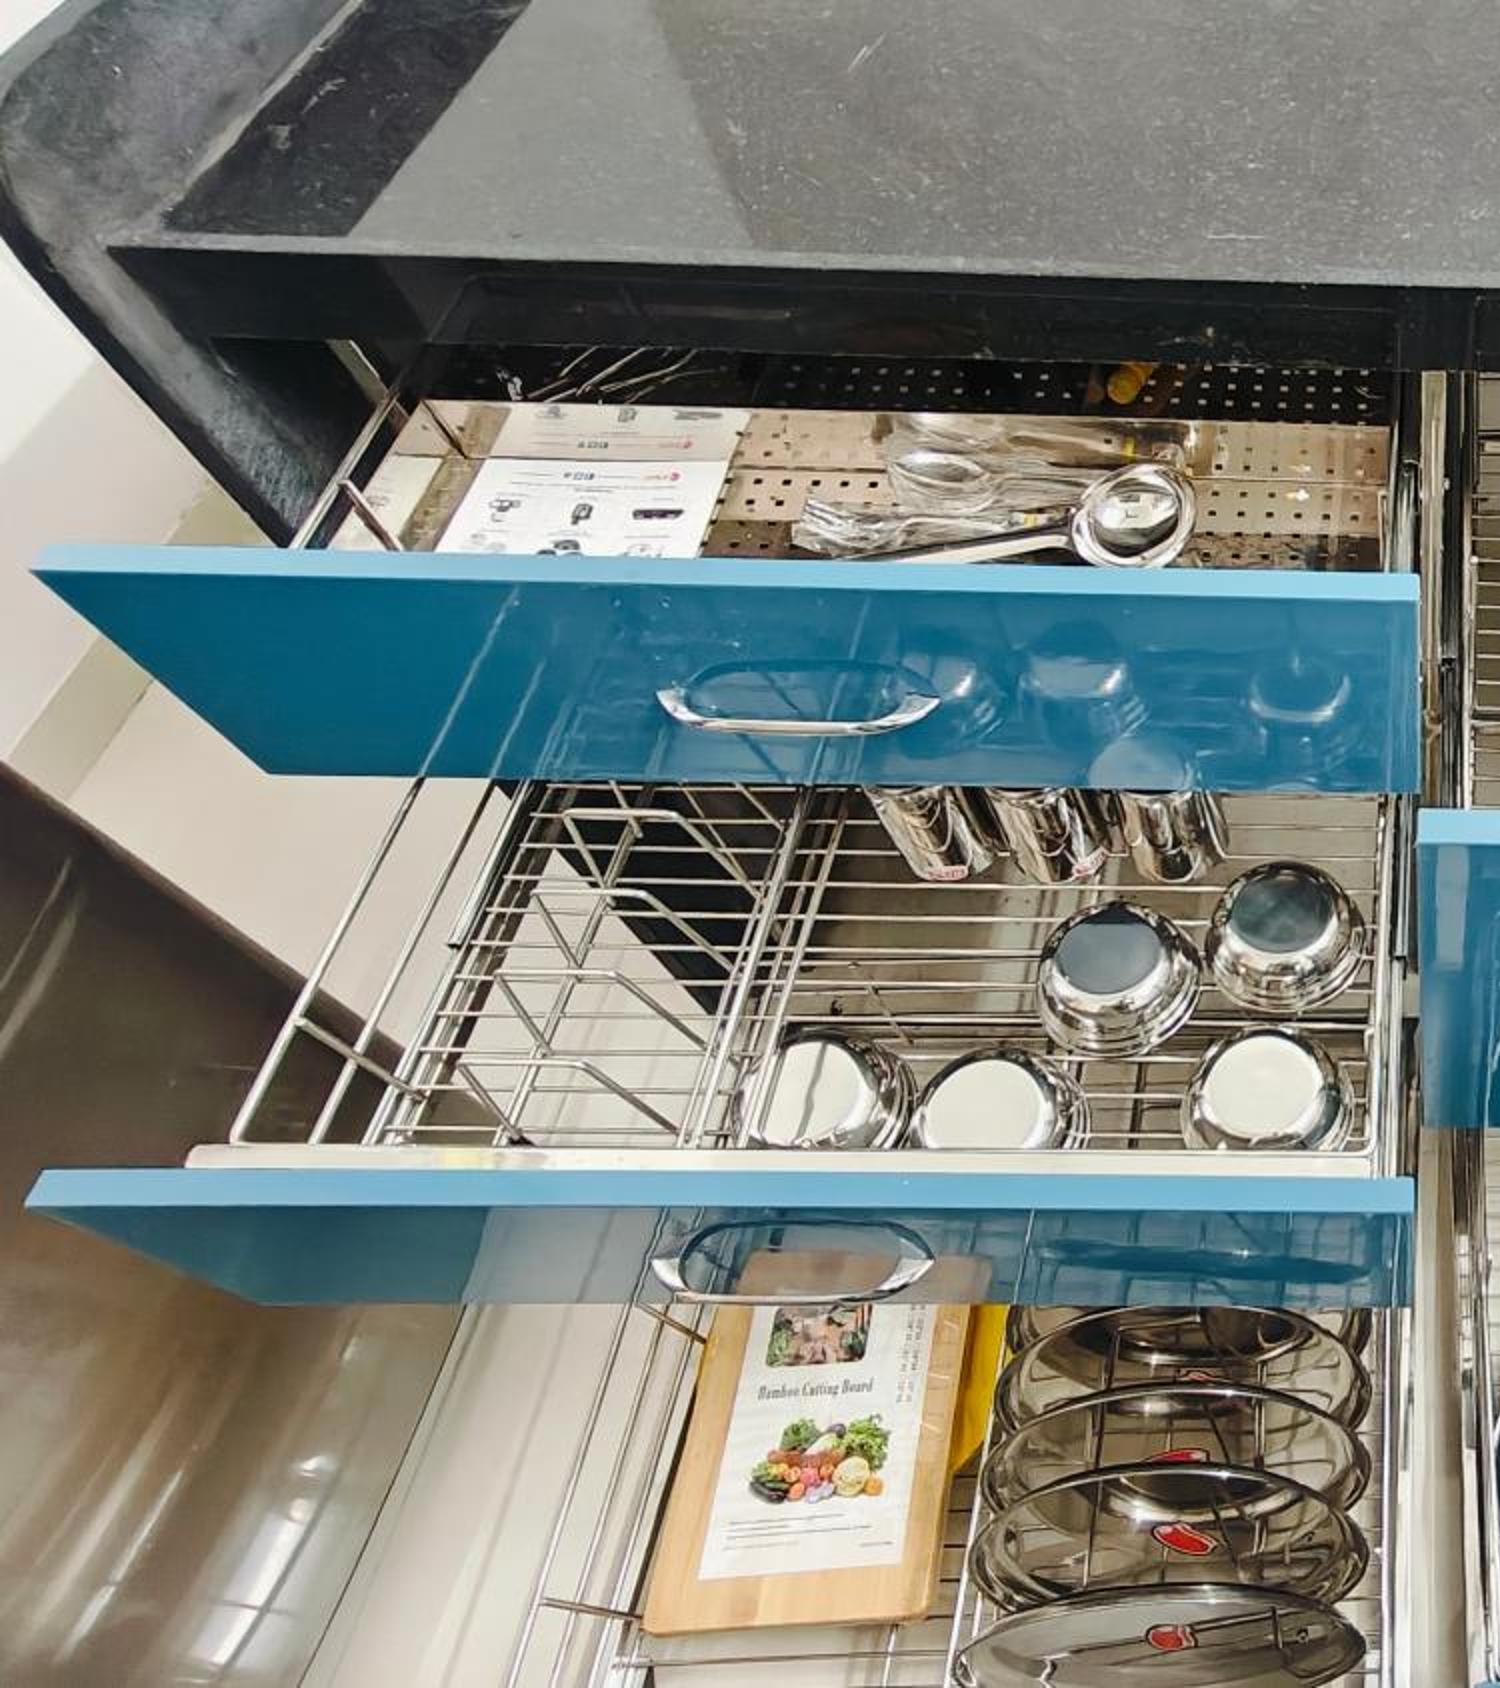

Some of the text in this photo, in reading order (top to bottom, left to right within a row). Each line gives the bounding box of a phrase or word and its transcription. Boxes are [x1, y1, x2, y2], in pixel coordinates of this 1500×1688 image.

[757, 1376, 874, 1400] Bamboo Cutting Board
